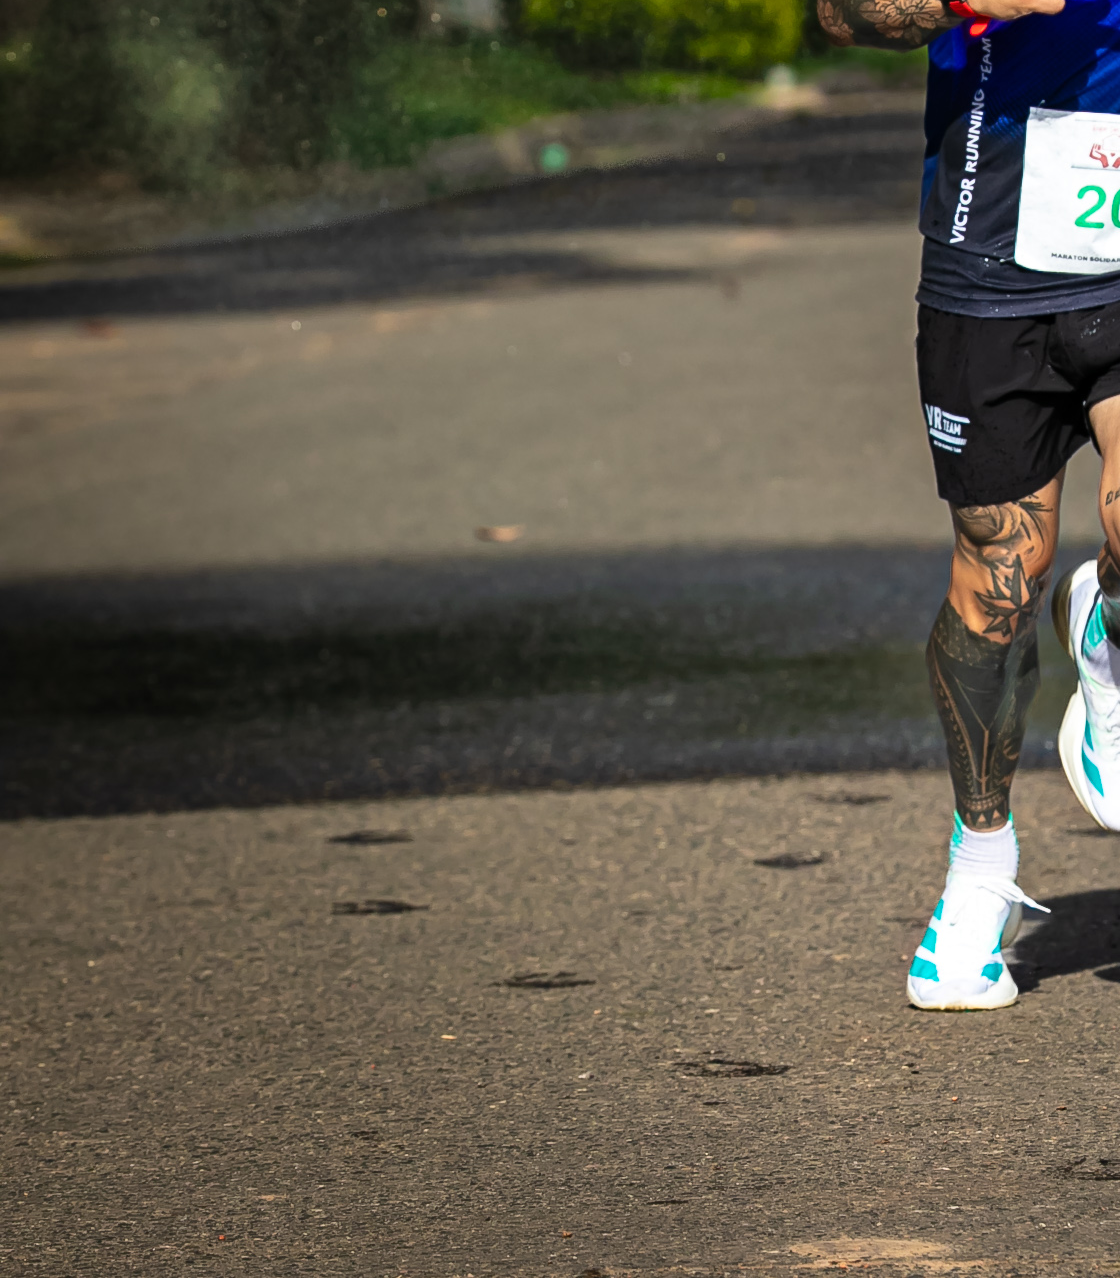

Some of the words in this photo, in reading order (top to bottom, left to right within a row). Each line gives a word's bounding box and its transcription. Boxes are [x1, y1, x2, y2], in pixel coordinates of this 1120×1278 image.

[950, 178, 976, 244] VICTOR
[965, 88, 985, 172] RUNNING
[980, 37, 993, 83] TEAM
[1051, 252, 1088, 261] MARATON
[925, 403, 942, 430] VR
[943, 419, 961, 435] TEAM
